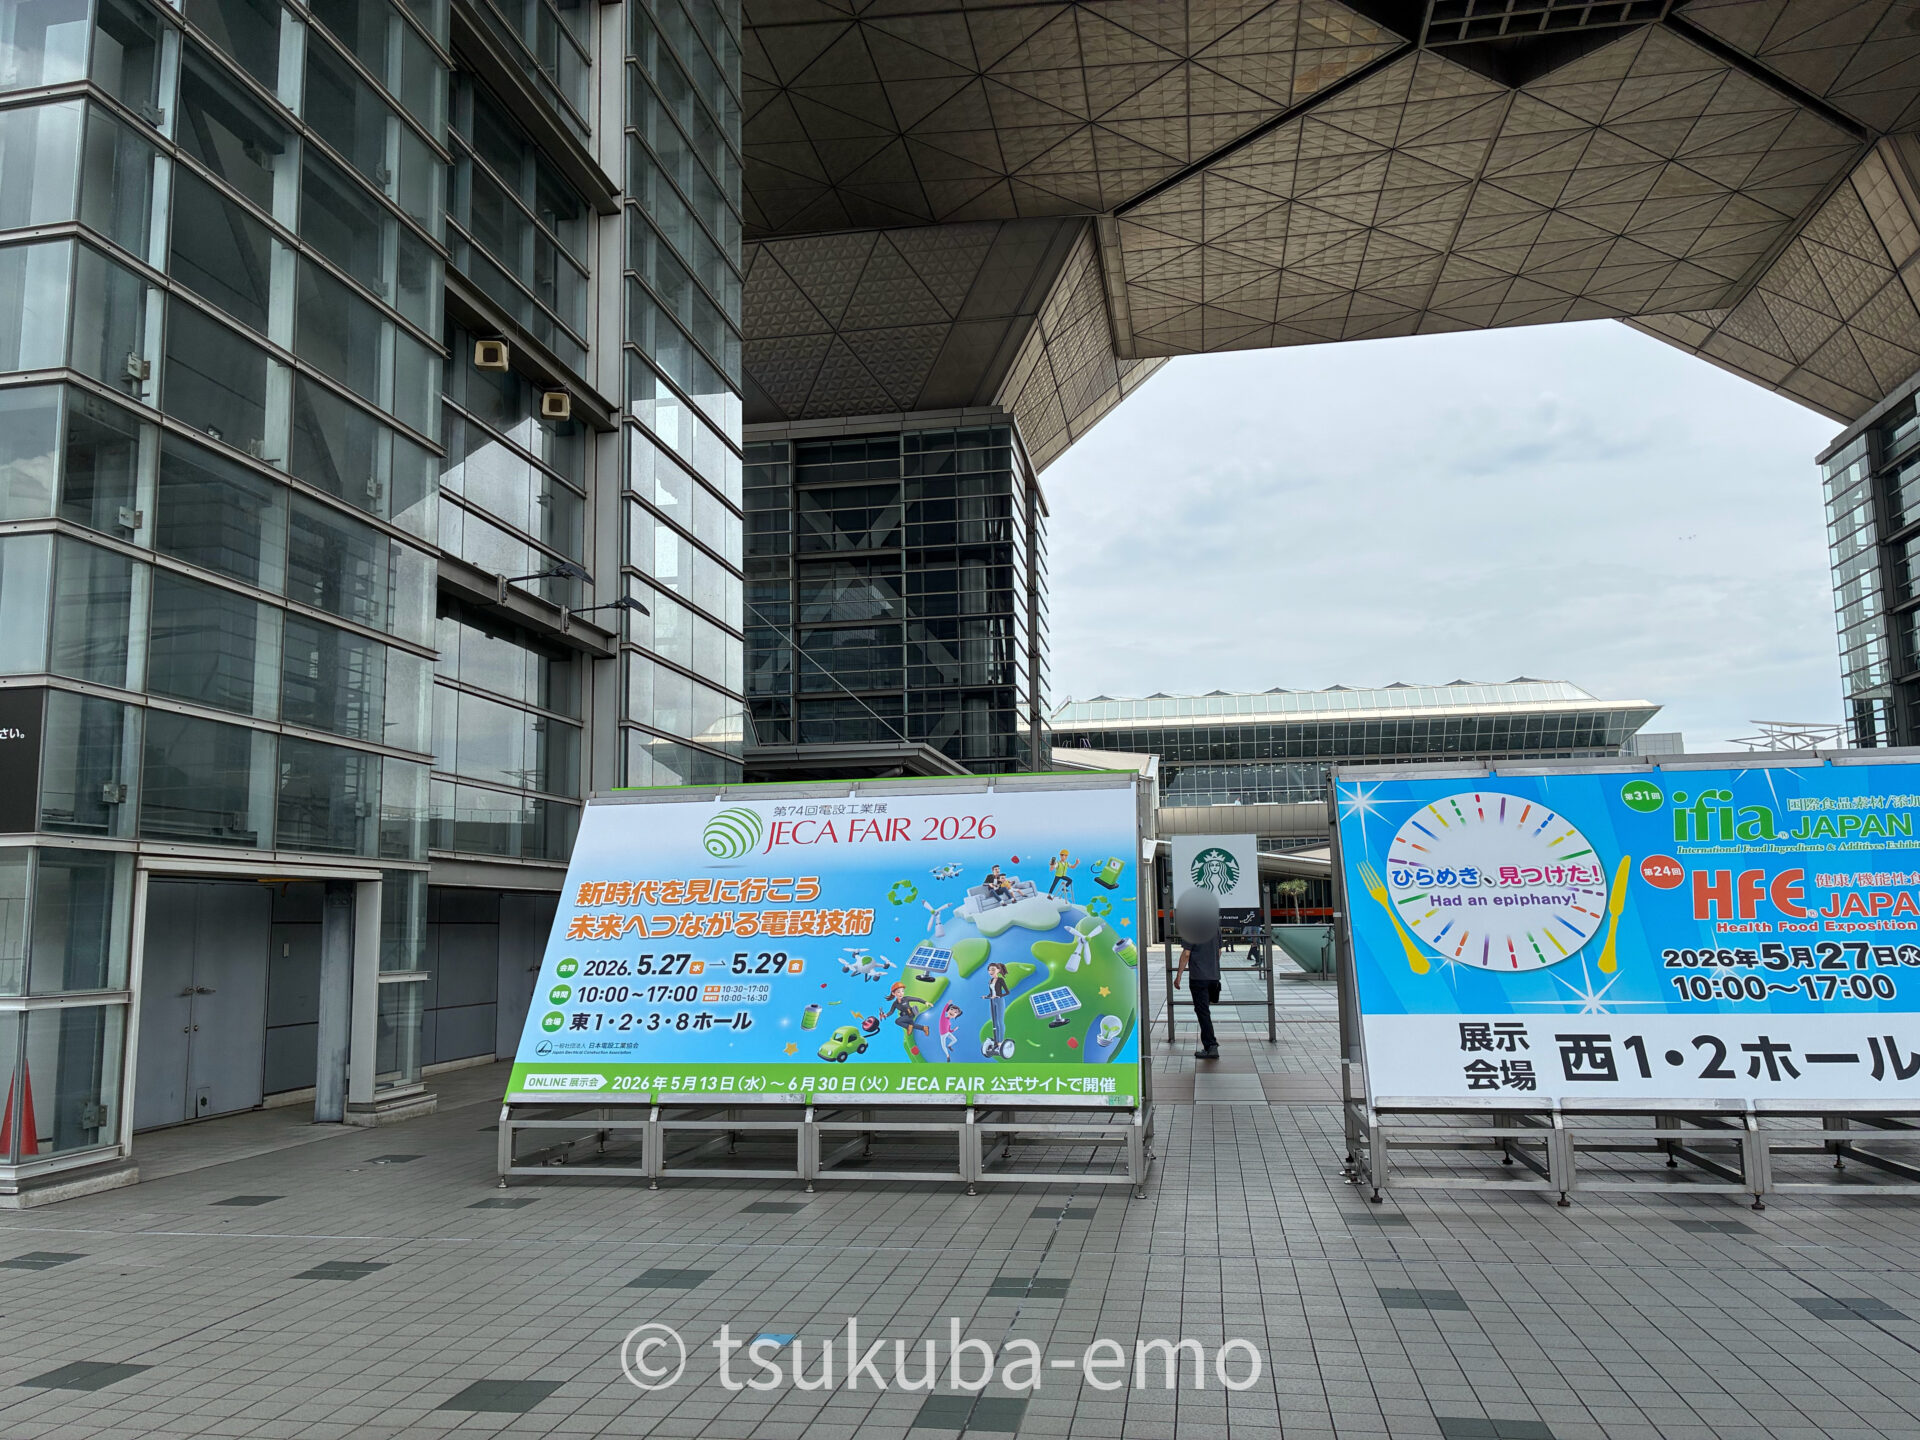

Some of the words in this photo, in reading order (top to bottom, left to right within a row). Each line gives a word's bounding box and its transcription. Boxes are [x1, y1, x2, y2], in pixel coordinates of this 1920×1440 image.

[1625, 790, 1661, 801] 第31回
[773, 803, 888, 817] 第74回電設工業展
[1791, 813, 1912, 839] JAPAN
[762, 819, 838, 855] JECA
[848, 817, 912, 843] FAIR
[920, 815, 997, 841] 2026
[1677, 845, 1740, 854] International
[1742, 845, 1768, 853] Food
[1769, 843, 1824, 854] Ingredients
[1838, 842, 1885, 850] Additives
[1644, 866, 1682, 877] 第24回
[575, 877, 820, 906] 新時代を見に行こう
[1430, 894, 1462, 907] Had
[1468, 896, 1487, 906] an
[1493, 893, 1578, 907] epiphany!
[1820, 891, 1920, 917] JAPA
[566, 909, 873, 940] 未来へつながる電設技術
[1716, 922, 1772, 933] Health
[1778, 921, 1819, 932] Food
[1824, 920, 1917, 933] Exposition
[559, 964, 576, 973] 会期
[637, 953, 692, 976] 5.27
[731, 952, 787, 975] 5.29
[551, 990, 569, 999] 時間
[544, 1018, 562, 1027] 会場
[1459, 1022, 1530, 1052] 展示
[528, 1077, 567, 1087] ONLINE
[569, 1077, 599, 1087] 展示会
[1463, 1058, 1537, 1091] 会場
[896, 1076, 941, 1091] JECA
[945, 1076, 985, 1091] FAIR
[991, 1076, 1117, 1093] 公式サイトで開催
